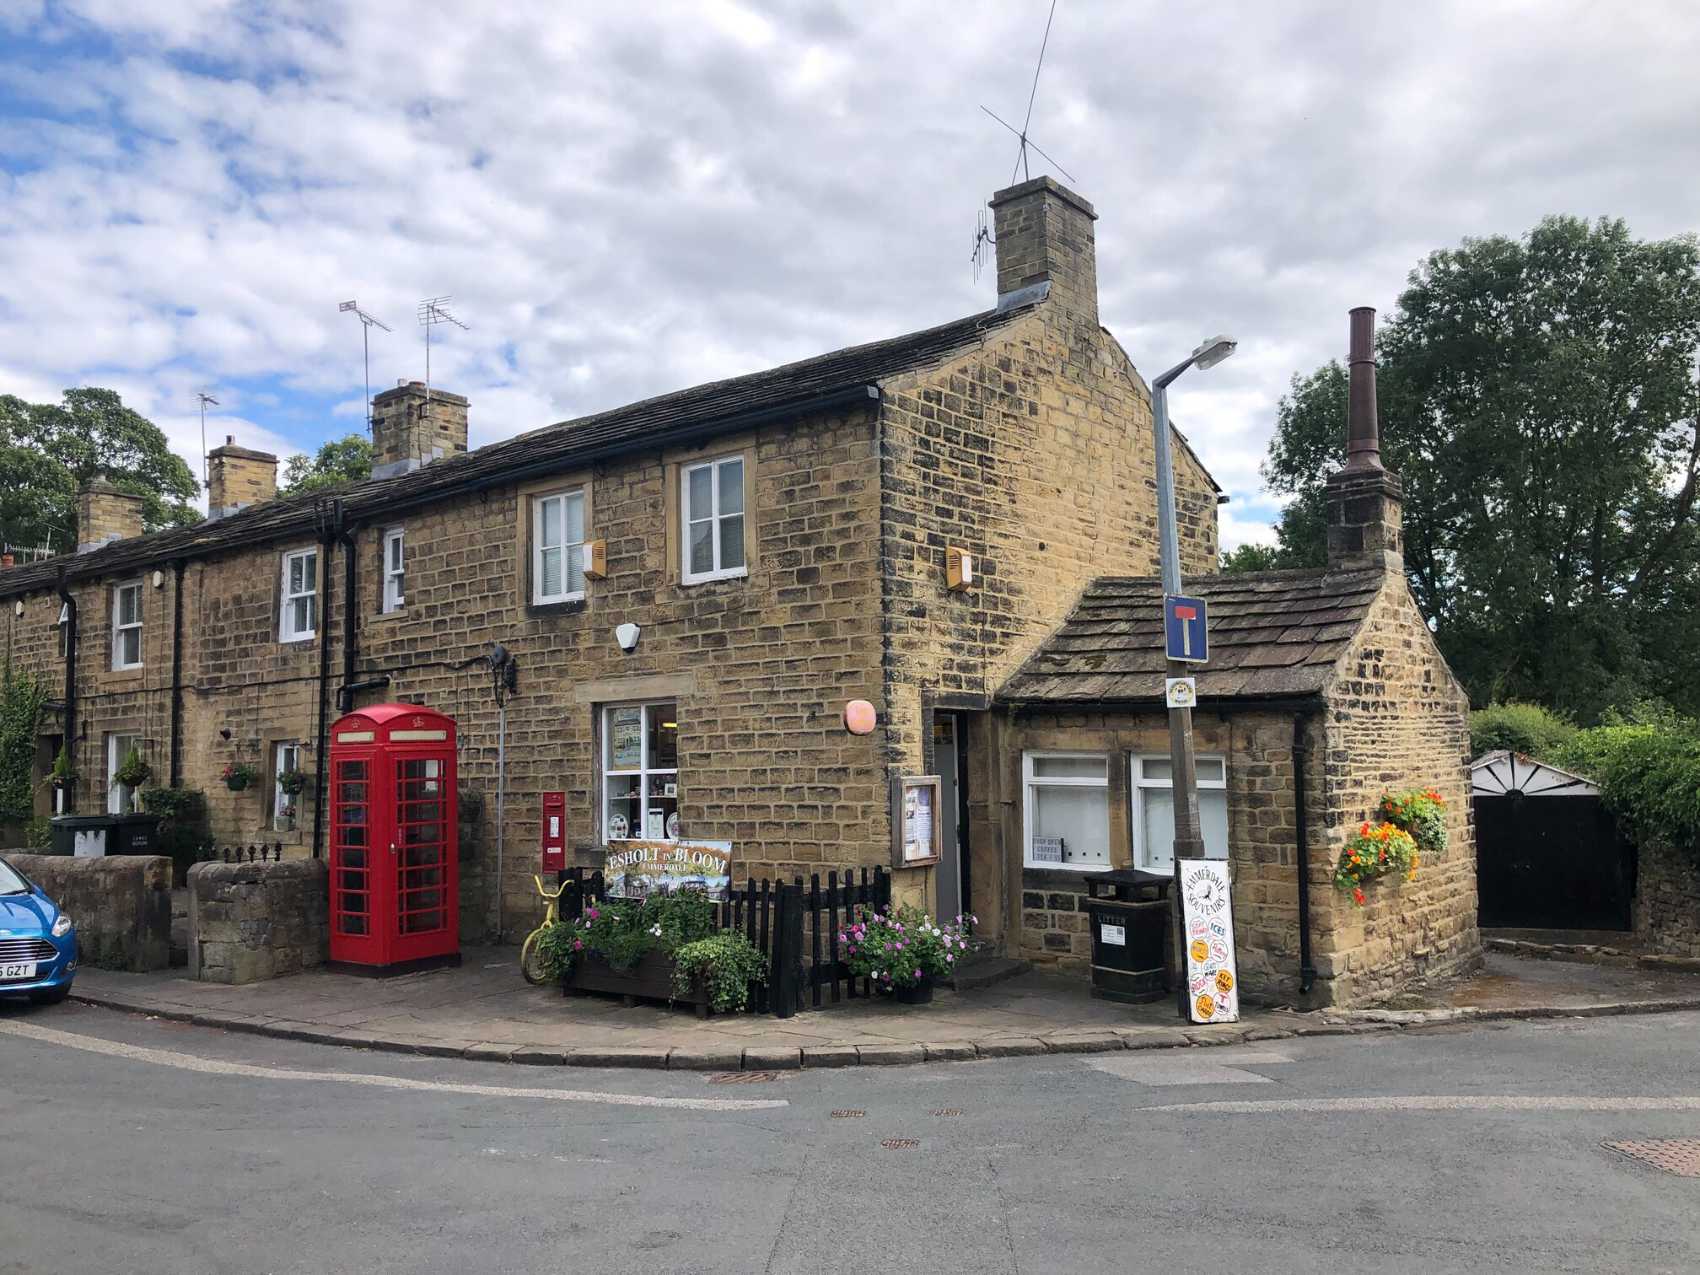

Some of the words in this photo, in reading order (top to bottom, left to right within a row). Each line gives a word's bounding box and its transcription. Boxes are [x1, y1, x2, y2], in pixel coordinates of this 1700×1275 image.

[609, 847, 661, 870] ESHOLT
[663, 853, 672, 861] IN
[675, 848, 727, 873] BLOOM
[1186, 869, 1225, 891] EMMERDALE
[1187, 893, 1226, 915] SOUVENIRS
[1210, 923, 1225, 936] ICES
[7, 965, 29, 976] GZT
